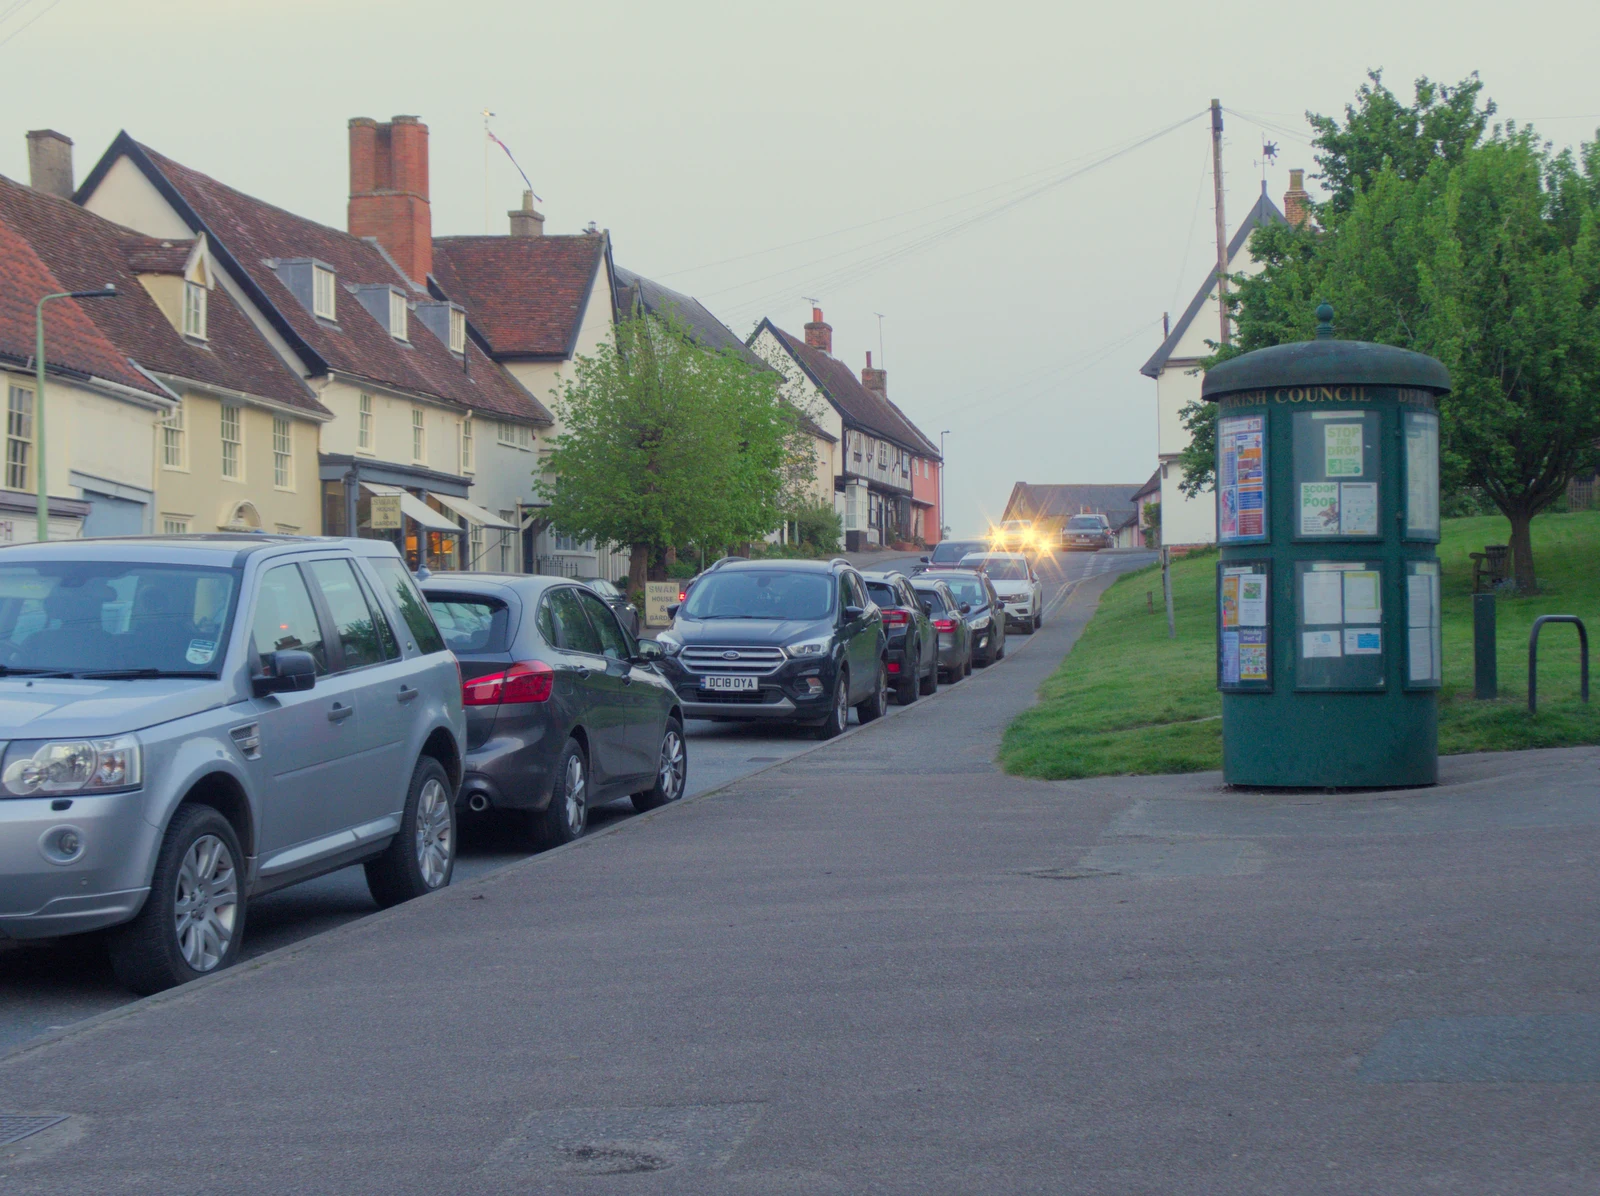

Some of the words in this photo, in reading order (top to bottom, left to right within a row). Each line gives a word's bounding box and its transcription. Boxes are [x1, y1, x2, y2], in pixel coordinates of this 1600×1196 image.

[1275, 387, 1371, 403] COUNCIL
[1328, 427, 1360, 437] STOP
[1328, 446, 1360, 455] DROP
[1303, 485, 1336, 493] SCOOP
[1303, 497, 1337, 507] POOP
[660, 604, 667, 612] &
[709, 677, 731, 688] DC18
[734, 678, 753, 688] OYA
